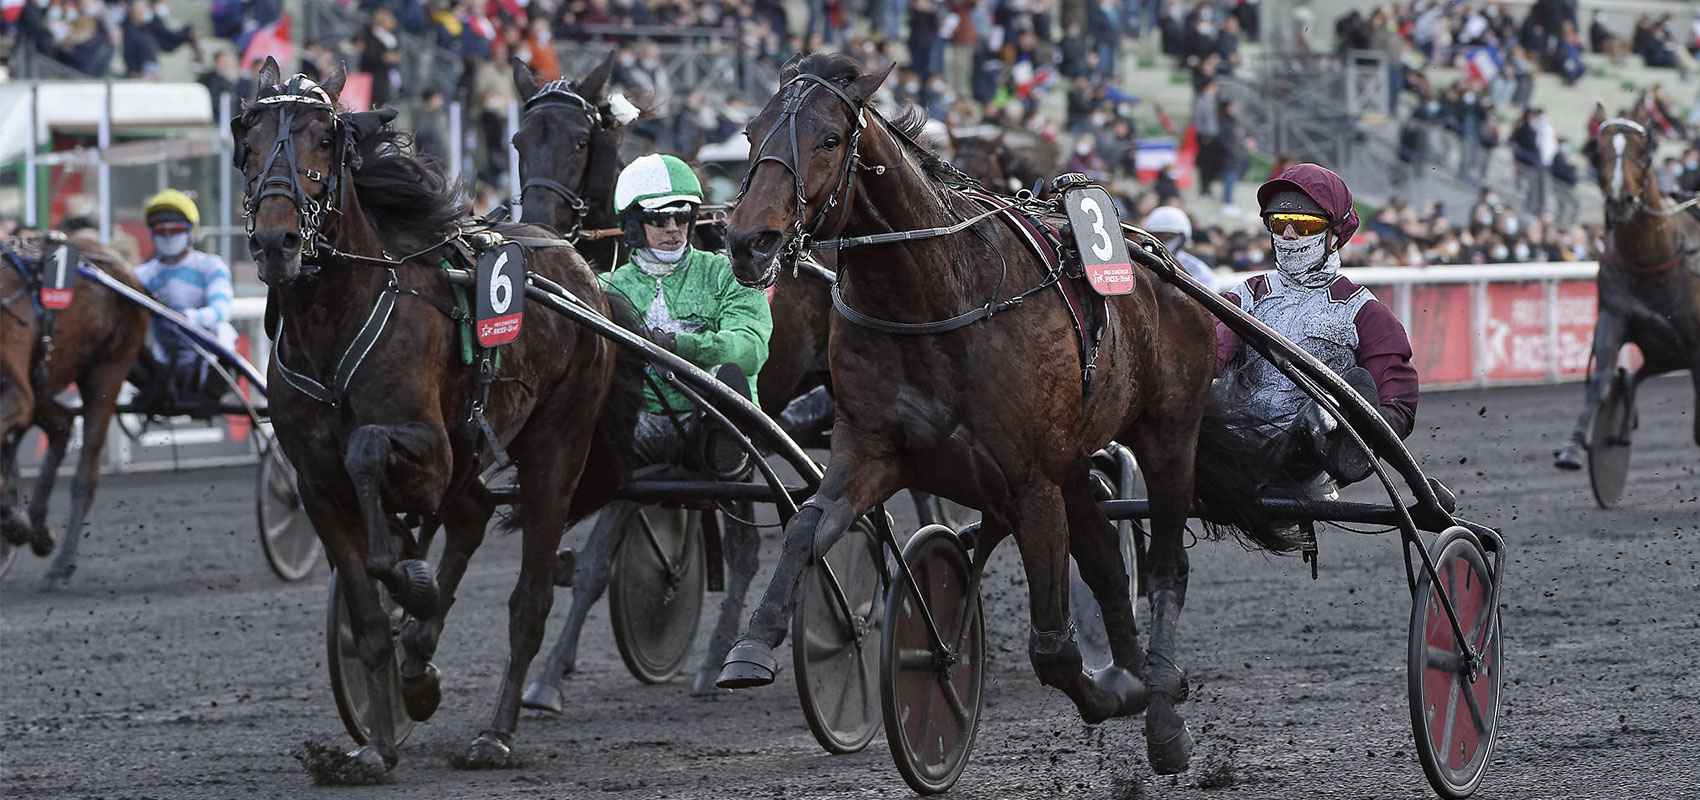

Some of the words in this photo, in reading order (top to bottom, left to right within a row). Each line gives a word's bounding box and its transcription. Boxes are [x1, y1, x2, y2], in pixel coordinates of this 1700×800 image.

[1081, 197, 1113, 262] 3
[53, 244, 68, 290] 1
[490, 251, 513, 314] 6
